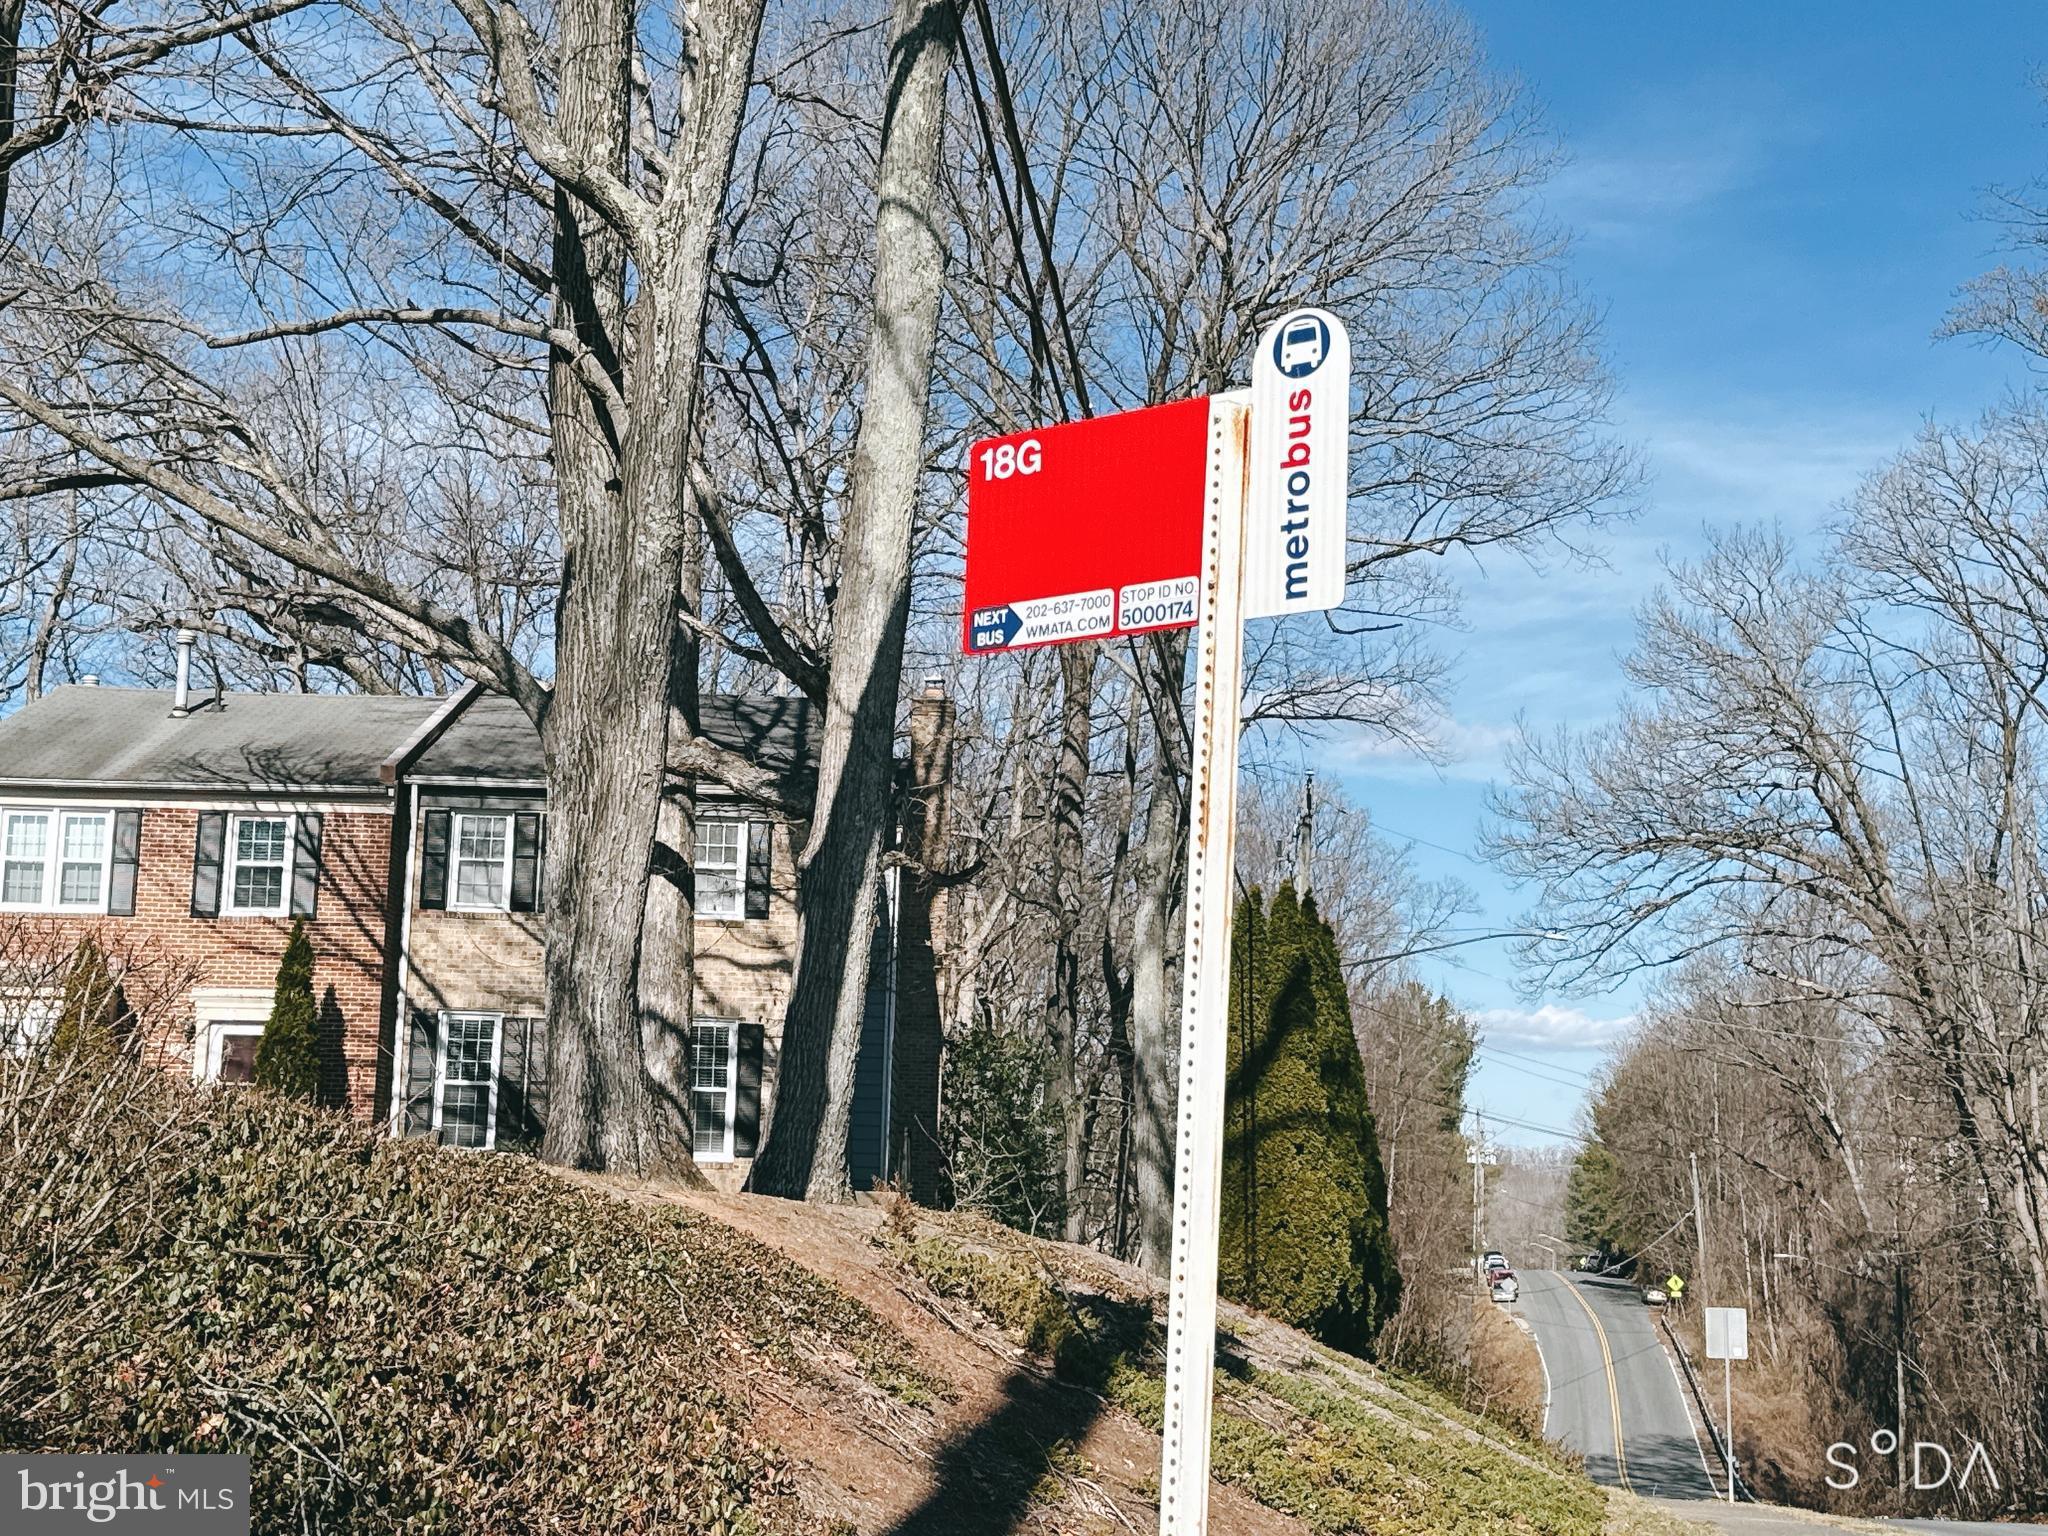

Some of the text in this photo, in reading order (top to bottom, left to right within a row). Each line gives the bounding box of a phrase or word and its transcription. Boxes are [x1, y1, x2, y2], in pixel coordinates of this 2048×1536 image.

[980, 439, 1042, 481] 18G
[1280, 388, 1312, 600] metrobus
[1121, 585, 1155, 604] STOP
[1158, 582, 1171, 599] ID
[973, 609, 1009, 628] NEXT
[1025, 594, 1111, 619] 202-637-7000
[1121, 600, 1193, 626] 5000174
[976, 629, 1005, 647] BUS
[1025, 615, 1111, 639] WMATA.COM
